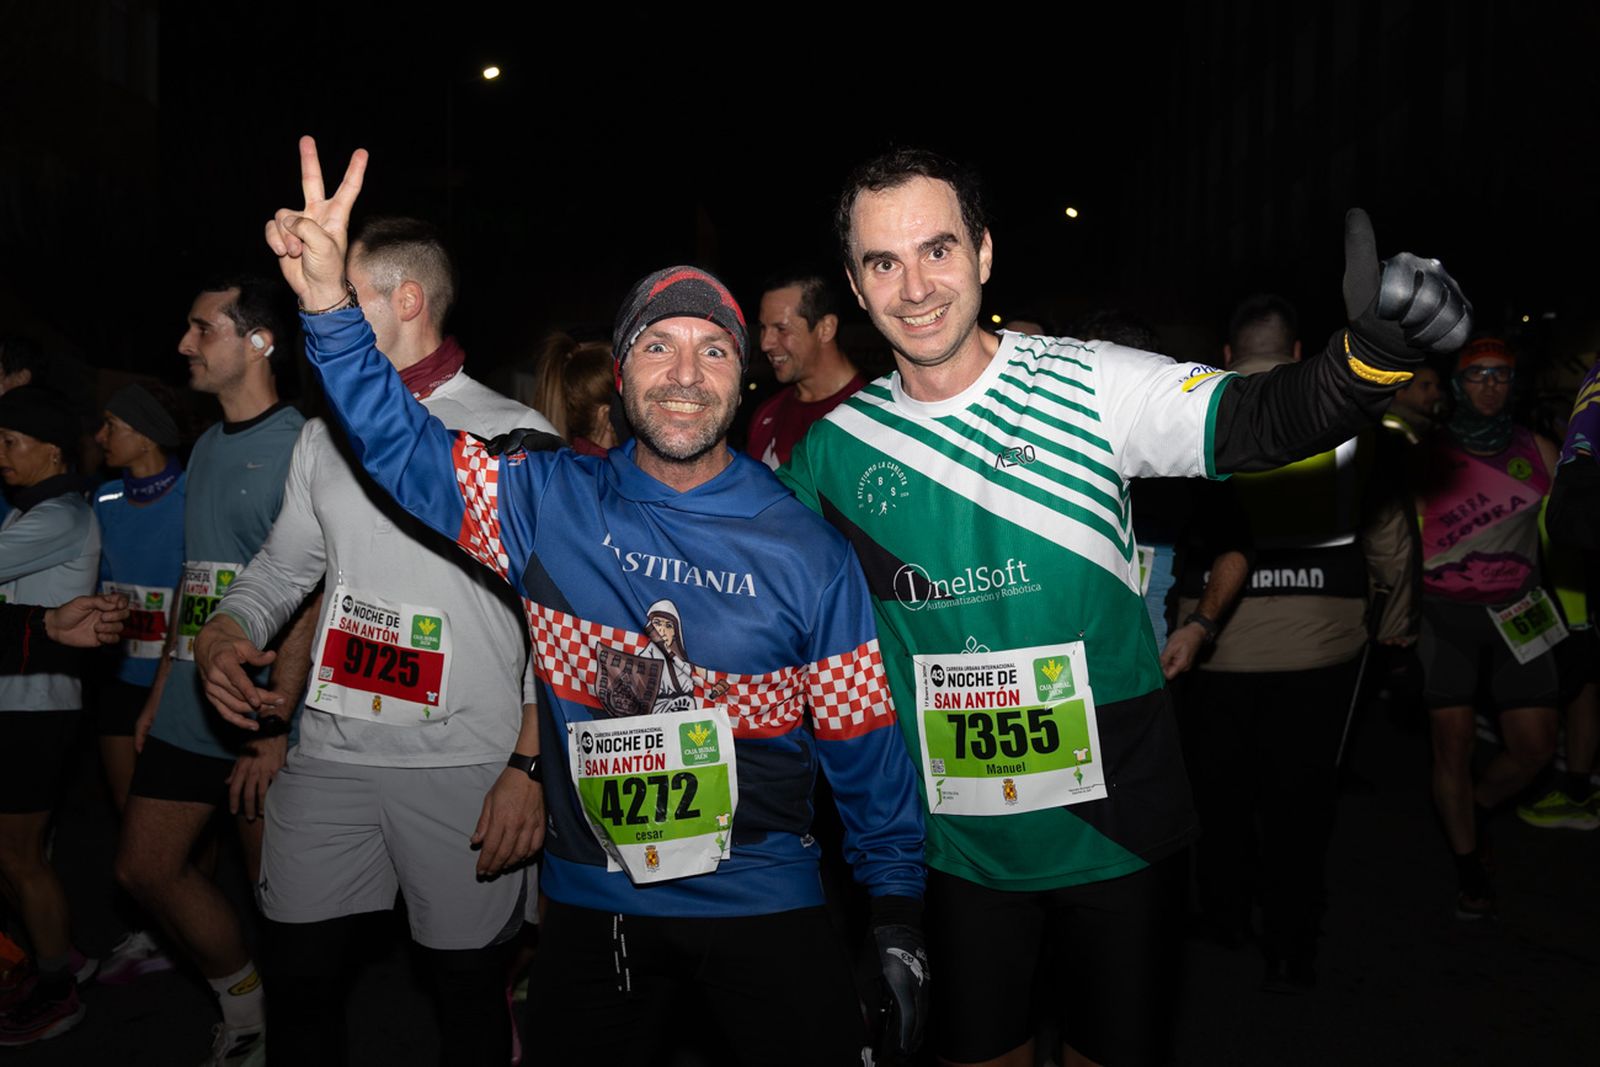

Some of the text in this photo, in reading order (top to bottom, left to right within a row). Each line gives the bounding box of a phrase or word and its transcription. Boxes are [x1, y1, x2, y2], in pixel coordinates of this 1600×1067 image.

[994, 445, 1036, 471] AERO
[926, 590, 996, 612] Automatización
[353, 605, 385, 625] NOCHE
[385, 614, 400, 629] DE
[339, 616, 400, 645] SAN ANTÓN
[343, 637, 420, 688] 9725
[947, 669, 1018, 688] NOCHE DE
[934, 686, 1020, 710] SAN ANTÓN
[596, 735, 641, 754] NOCHE
[645, 733, 664, 749] DE
[947, 707, 1061, 761] 7355
[585, 750, 666, 776] SAN ANTÓN
[986, 761, 1027, 776] Manuel
[601, 772, 701, 826] 4272
[635, 829, 664, 841] cesar
